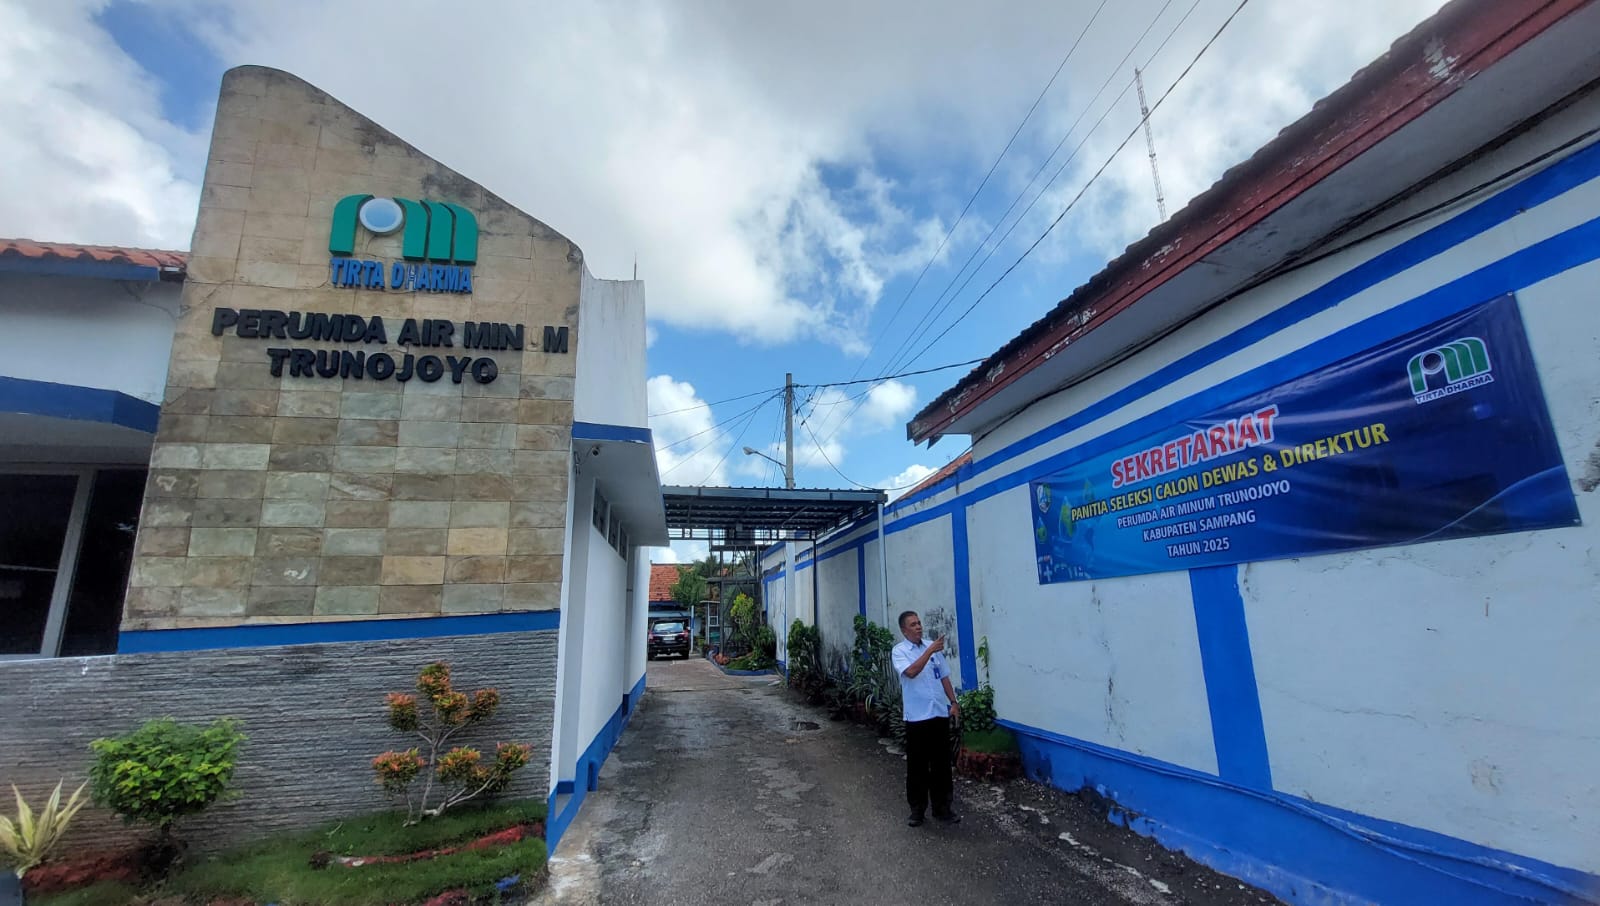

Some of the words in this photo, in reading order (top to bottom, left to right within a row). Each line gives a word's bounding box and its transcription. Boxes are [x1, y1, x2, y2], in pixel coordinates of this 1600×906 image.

[331, 257, 385, 288] TIRTA
[391, 261, 473, 294] DHARMA
[211, 308, 387, 345] PERUMDA
[397, 318, 455, 348] AIR
[464, 321, 569, 353] MINM
[268, 348, 498, 384] TRUNOJOYO
[1415, 387, 1446, 404] TIRTA
[1445, 374, 1494, 395] DHARMA
[1111, 405, 1279, 488] SEKRETARIAT
[1071, 500, 1109, 521] PANITIA
[1110, 487, 1153, 512] SELEKSI
[1155, 475, 1198, 500] CALON
[1202, 458, 1258, 489] DEWAS
[1263, 453, 1277, 473] &
[1280, 422, 1390, 468] DIREKTUR
[1117, 510, 1158, 528] PERUMDA
[1160, 505, 1176, 519] AIR
[1177, 497, 1215, 515] MINUM
[1218, 479, 1291, 508] TRUNOJOYO
[1143, 520, 1197, 542] KABUPATEN
[1200, 510, 1256, 532] SAMPANG
[1167, 542, 1200, 557] TAHUN
[1202, 537, 1229, 553] 2025
